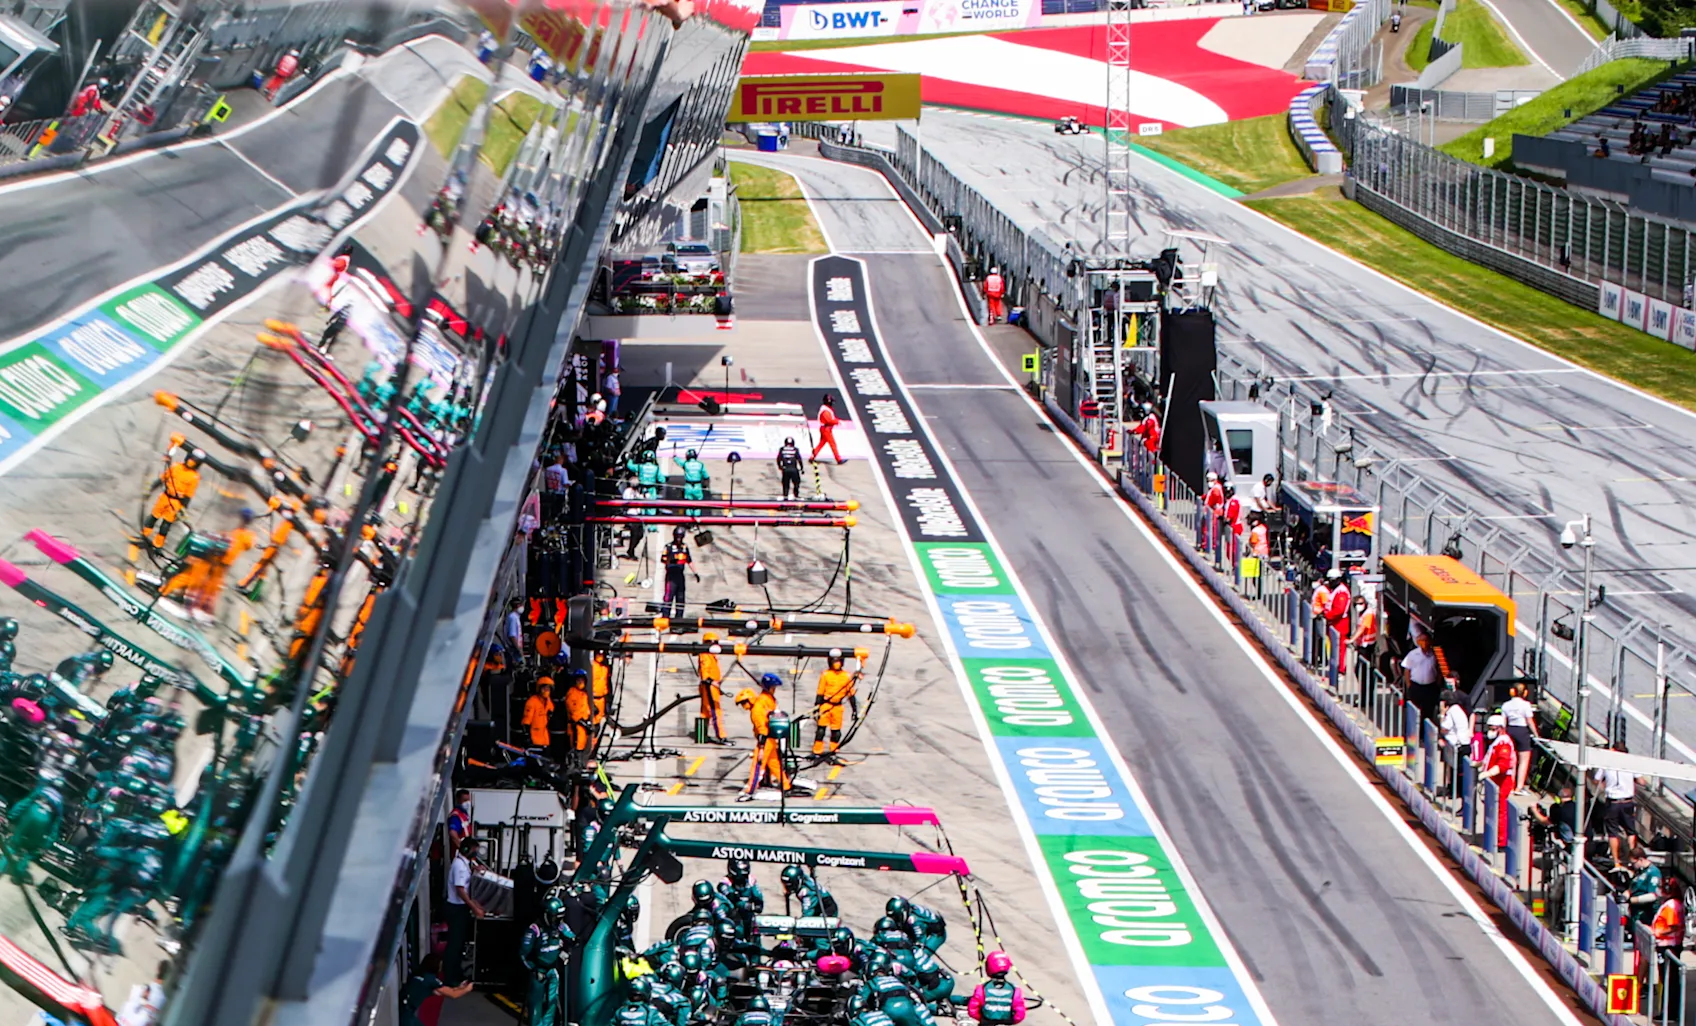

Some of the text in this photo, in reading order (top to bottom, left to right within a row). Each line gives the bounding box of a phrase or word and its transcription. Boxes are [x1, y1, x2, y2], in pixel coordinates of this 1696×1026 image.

[832, 10, 881, 29] BWT
[974, 9, 1019, 19] WORLD
[741, 81, 884, 115] PIRELLI
[952, 601, 1031, 649] aramco
[980, 667, 1073, 726] aramco
[1017, 747, 1124, 820] aramco
[684, 811, 838, 823] ASTON MARTIN Cognizant
[712, 847, 865, 867] ASTON MARTIN Cognizant
[1063, 850, 1192, 946] aramco
